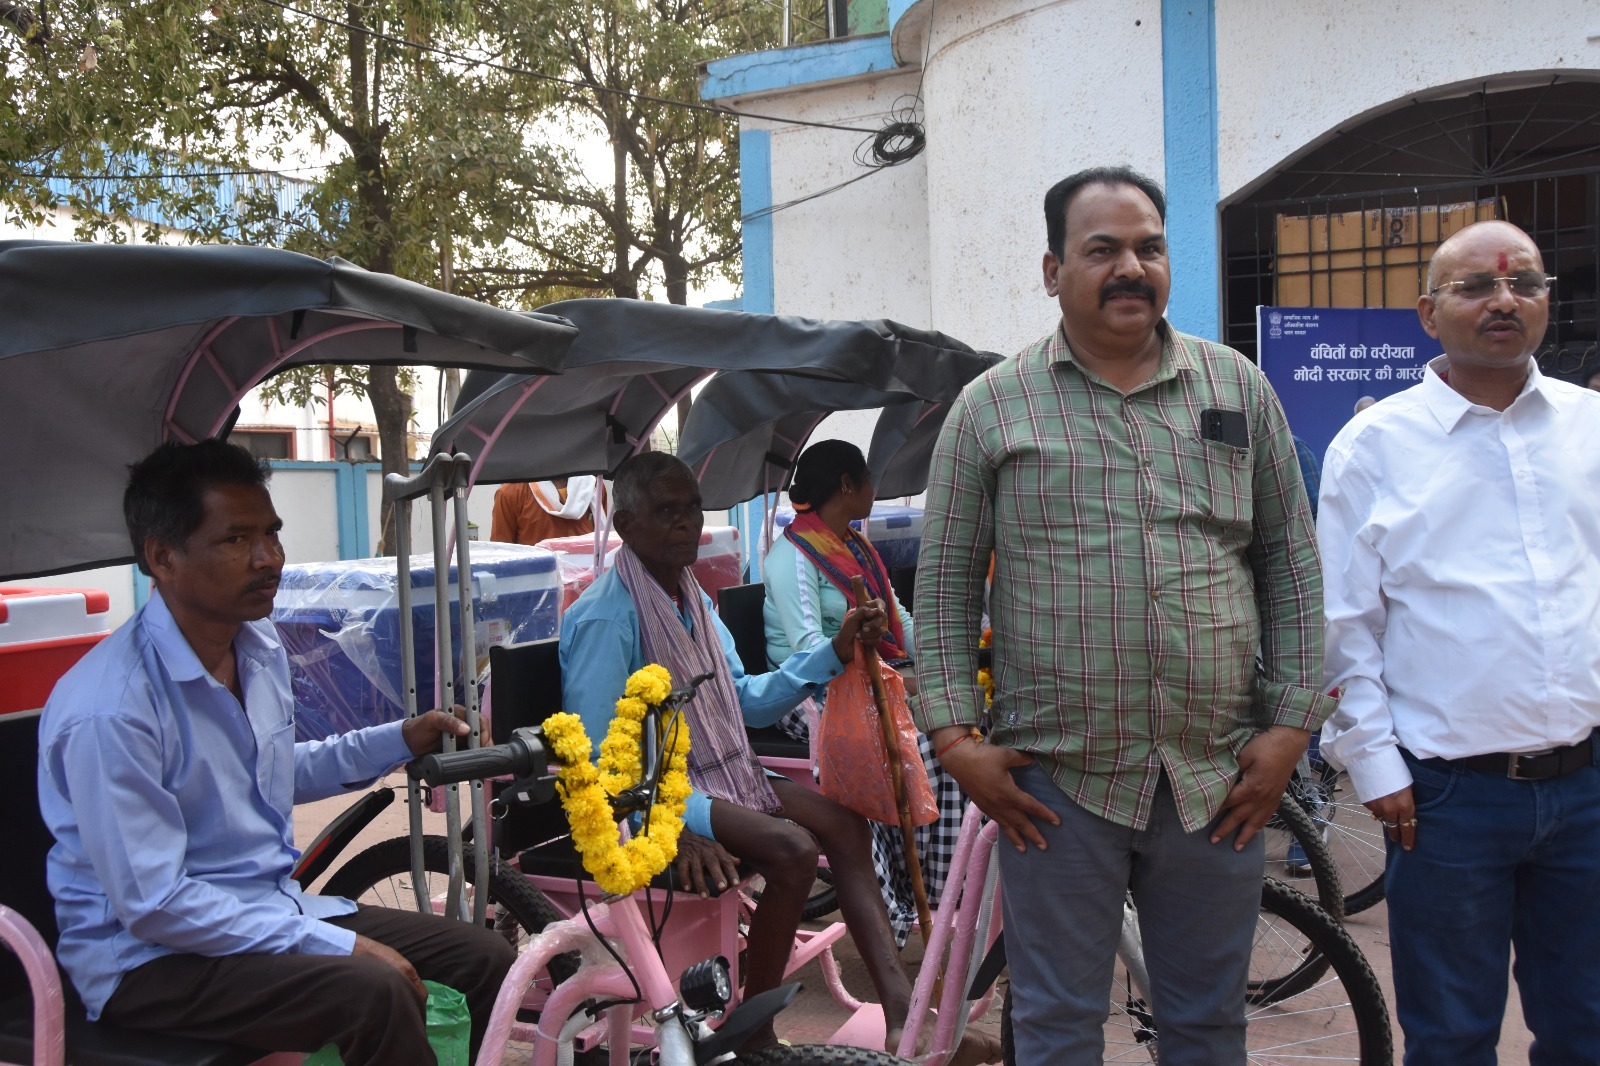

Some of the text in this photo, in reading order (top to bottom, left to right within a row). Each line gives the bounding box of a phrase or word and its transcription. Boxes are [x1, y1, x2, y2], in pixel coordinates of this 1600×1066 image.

[1310, 343, 1415, 360] वंचितों को वरीयता
[1294, 365, 1323, 382] मोदी
[1326, 368, 1372, 381] सरकार
[1375, 364, 1393, 380] की
